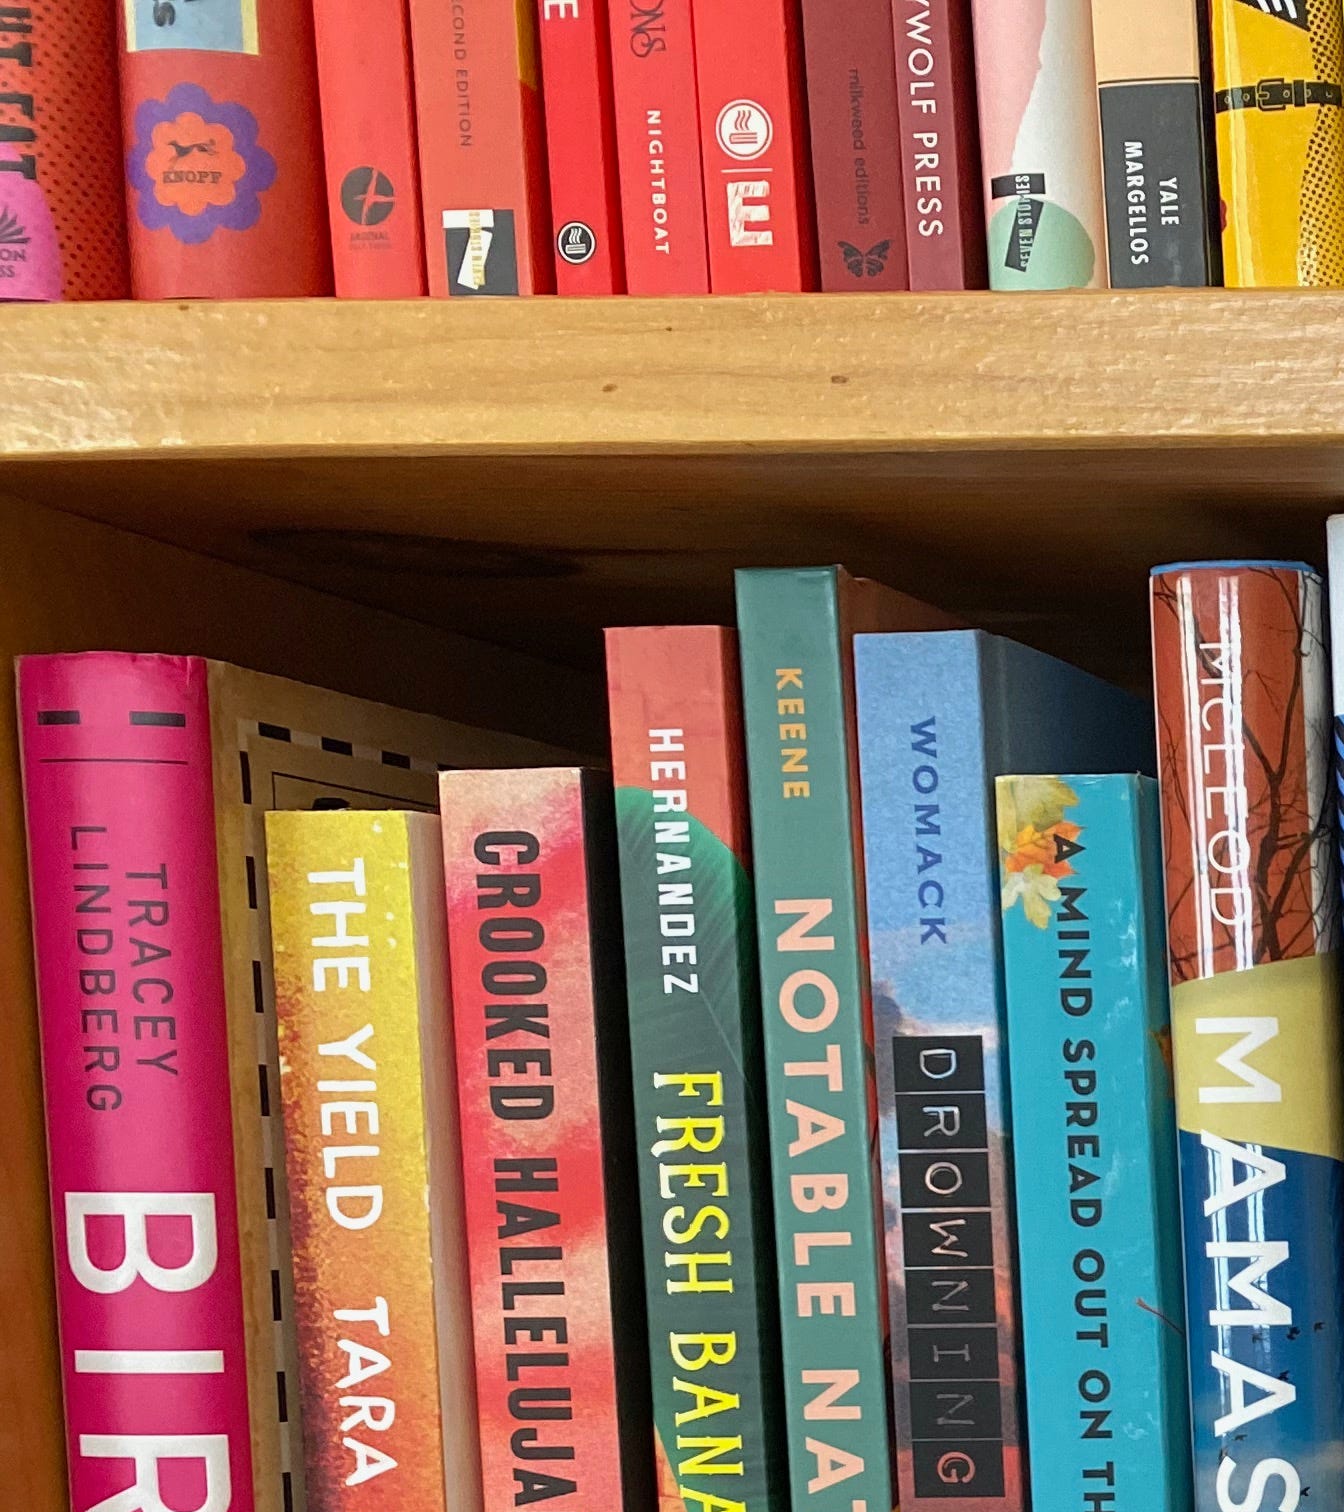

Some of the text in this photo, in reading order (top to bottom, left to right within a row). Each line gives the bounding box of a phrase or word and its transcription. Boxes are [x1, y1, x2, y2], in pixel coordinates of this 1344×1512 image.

[455, 69, 472, 147] EDITION
[646, 109, 670, 255] NIGHTBOAT
[912, 131, 944, 238] PRESS
[1123, 140, 1150, 265] MARGELLOS
[1158, 176, 1180, 226] YALE
[775, 667, 810, 800] KEENE
[1200, 642, 1251, 927] MCLEOD
[306, 857, 371, 992] THE
[648, 728, 699, 994] HERNANDEZ
[908, 715, 947, 946] WOMACK
[1052, 833, 1087, 864] A
[68, 826, 123, 1112] LINDBERG
[125, 863, 179, 1076] TRACEY
[473, 830, 556, 1121] CROOKED
[1056, 888, 1094, 1017] MIND
[317, 1024, 384, 1230] YIELD
[653, 1071, 733, 1294] FRESH
[774, 898, 856, 1318] NOTABLE
[1063, 1038, 1102, 1228] SPREAD
[918, 1048, 975, 1487] DROWNING
[1071, 1248, 1109, 1348] OUT
[333, 1296, 398, 1487] TARA
[1078, 1369, 1114, 1440] ON
